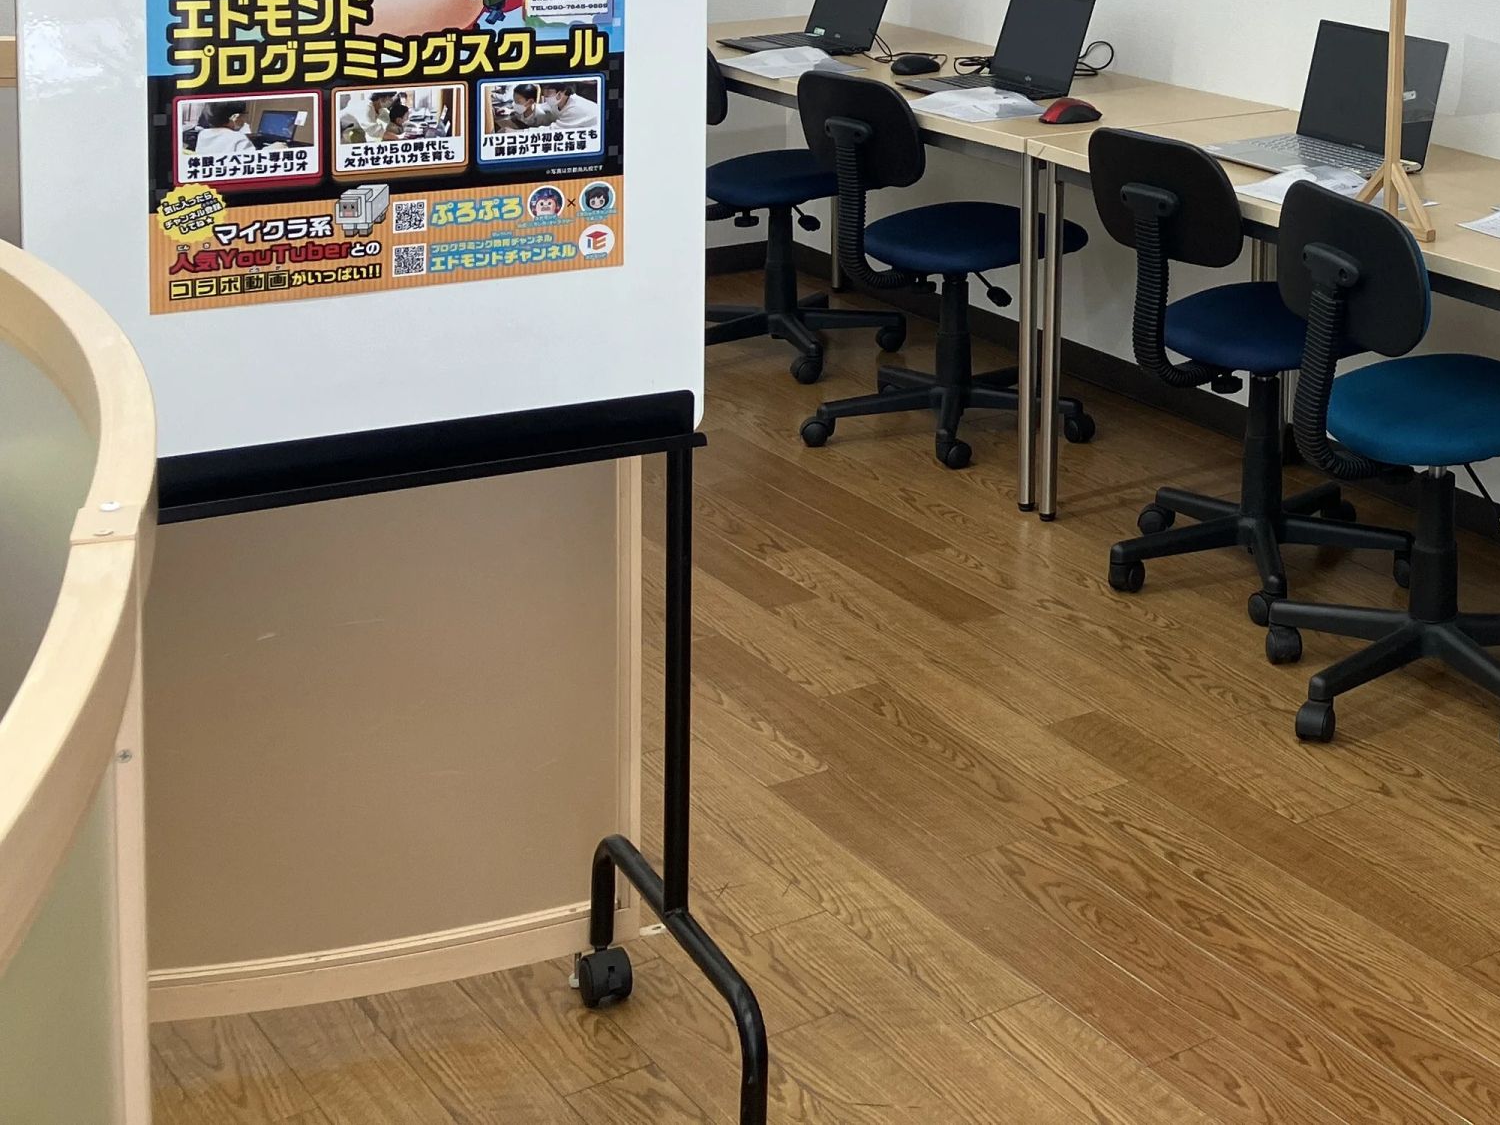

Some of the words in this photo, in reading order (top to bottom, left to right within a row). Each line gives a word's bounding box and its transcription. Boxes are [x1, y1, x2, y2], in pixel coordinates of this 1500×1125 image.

[173, 28, 605, 90] プログラミングスクール
[351, 141, 449, 156] これからの時代に
[482, 129, 598, 147] パソコンが初めてでも
[494, 141, 587, 156] 講師が丁寧に指導
[187, 149, 308, 168] 体験イベント専用の
[187, 161, 308, 179] オリジナルシナリオ
[344, 150, 455, 168] 欠かせない力を育む
[163, 192, 213, 216] 気に入ったら
[164, 203, 223, 229] チャンネル登録
[431, 196, 523, 226] ぷろぷろ
[213, 215, 333, 245] マイクラ系
[431, 234, 554, 254] プログラミングチャンネル
[170, 241, 381, 274] 人気YouTuberとの
[430, 243, 577, 273] エドモンドチャンネル
[170, 264, 382, 300] コラボ動画がいっぱい!!
